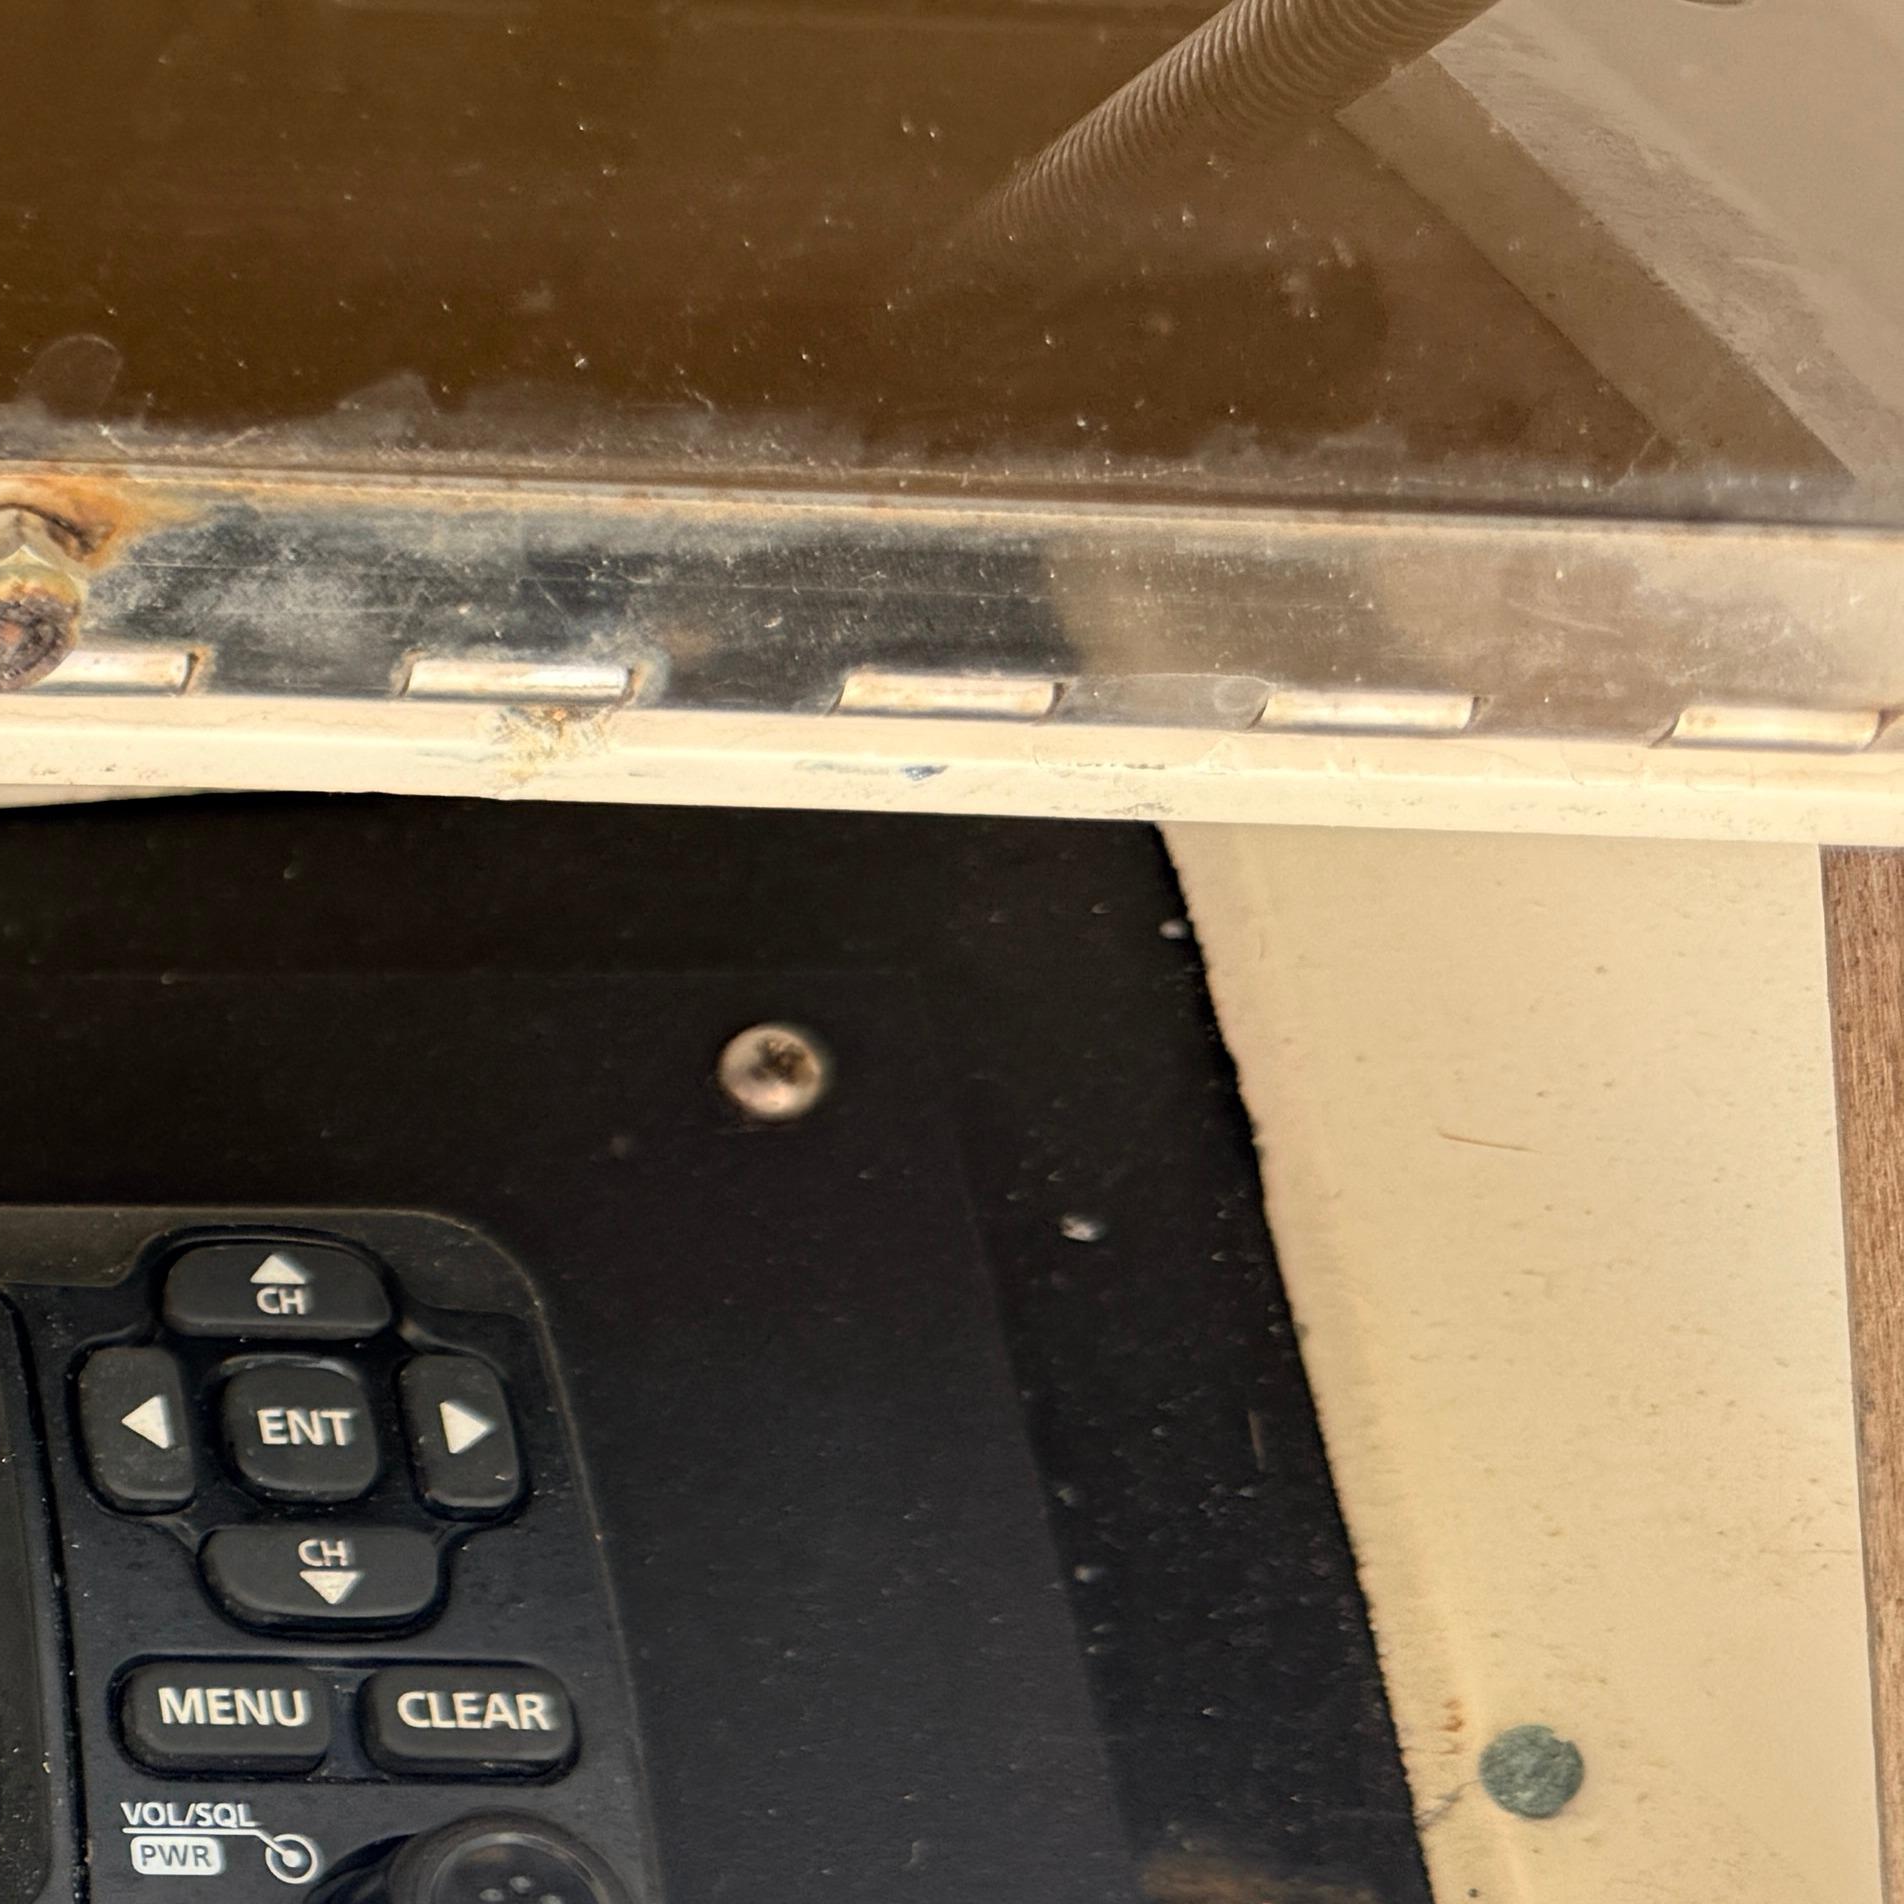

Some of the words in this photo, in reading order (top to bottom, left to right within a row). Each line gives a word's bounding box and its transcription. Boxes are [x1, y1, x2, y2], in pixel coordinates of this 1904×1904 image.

[256, 1287, 308, 1315] CH
[257, 1408, 353, 1446] ENT
[298, 1538, 350, 1567] CH
[157, 1686, 310, 1727] MENU
[396, 1691, 558, 1731] CLEAR
[121, 1801, 258, 1827] VOL/SQL
[140, 1844, 212, 1866] PWR
